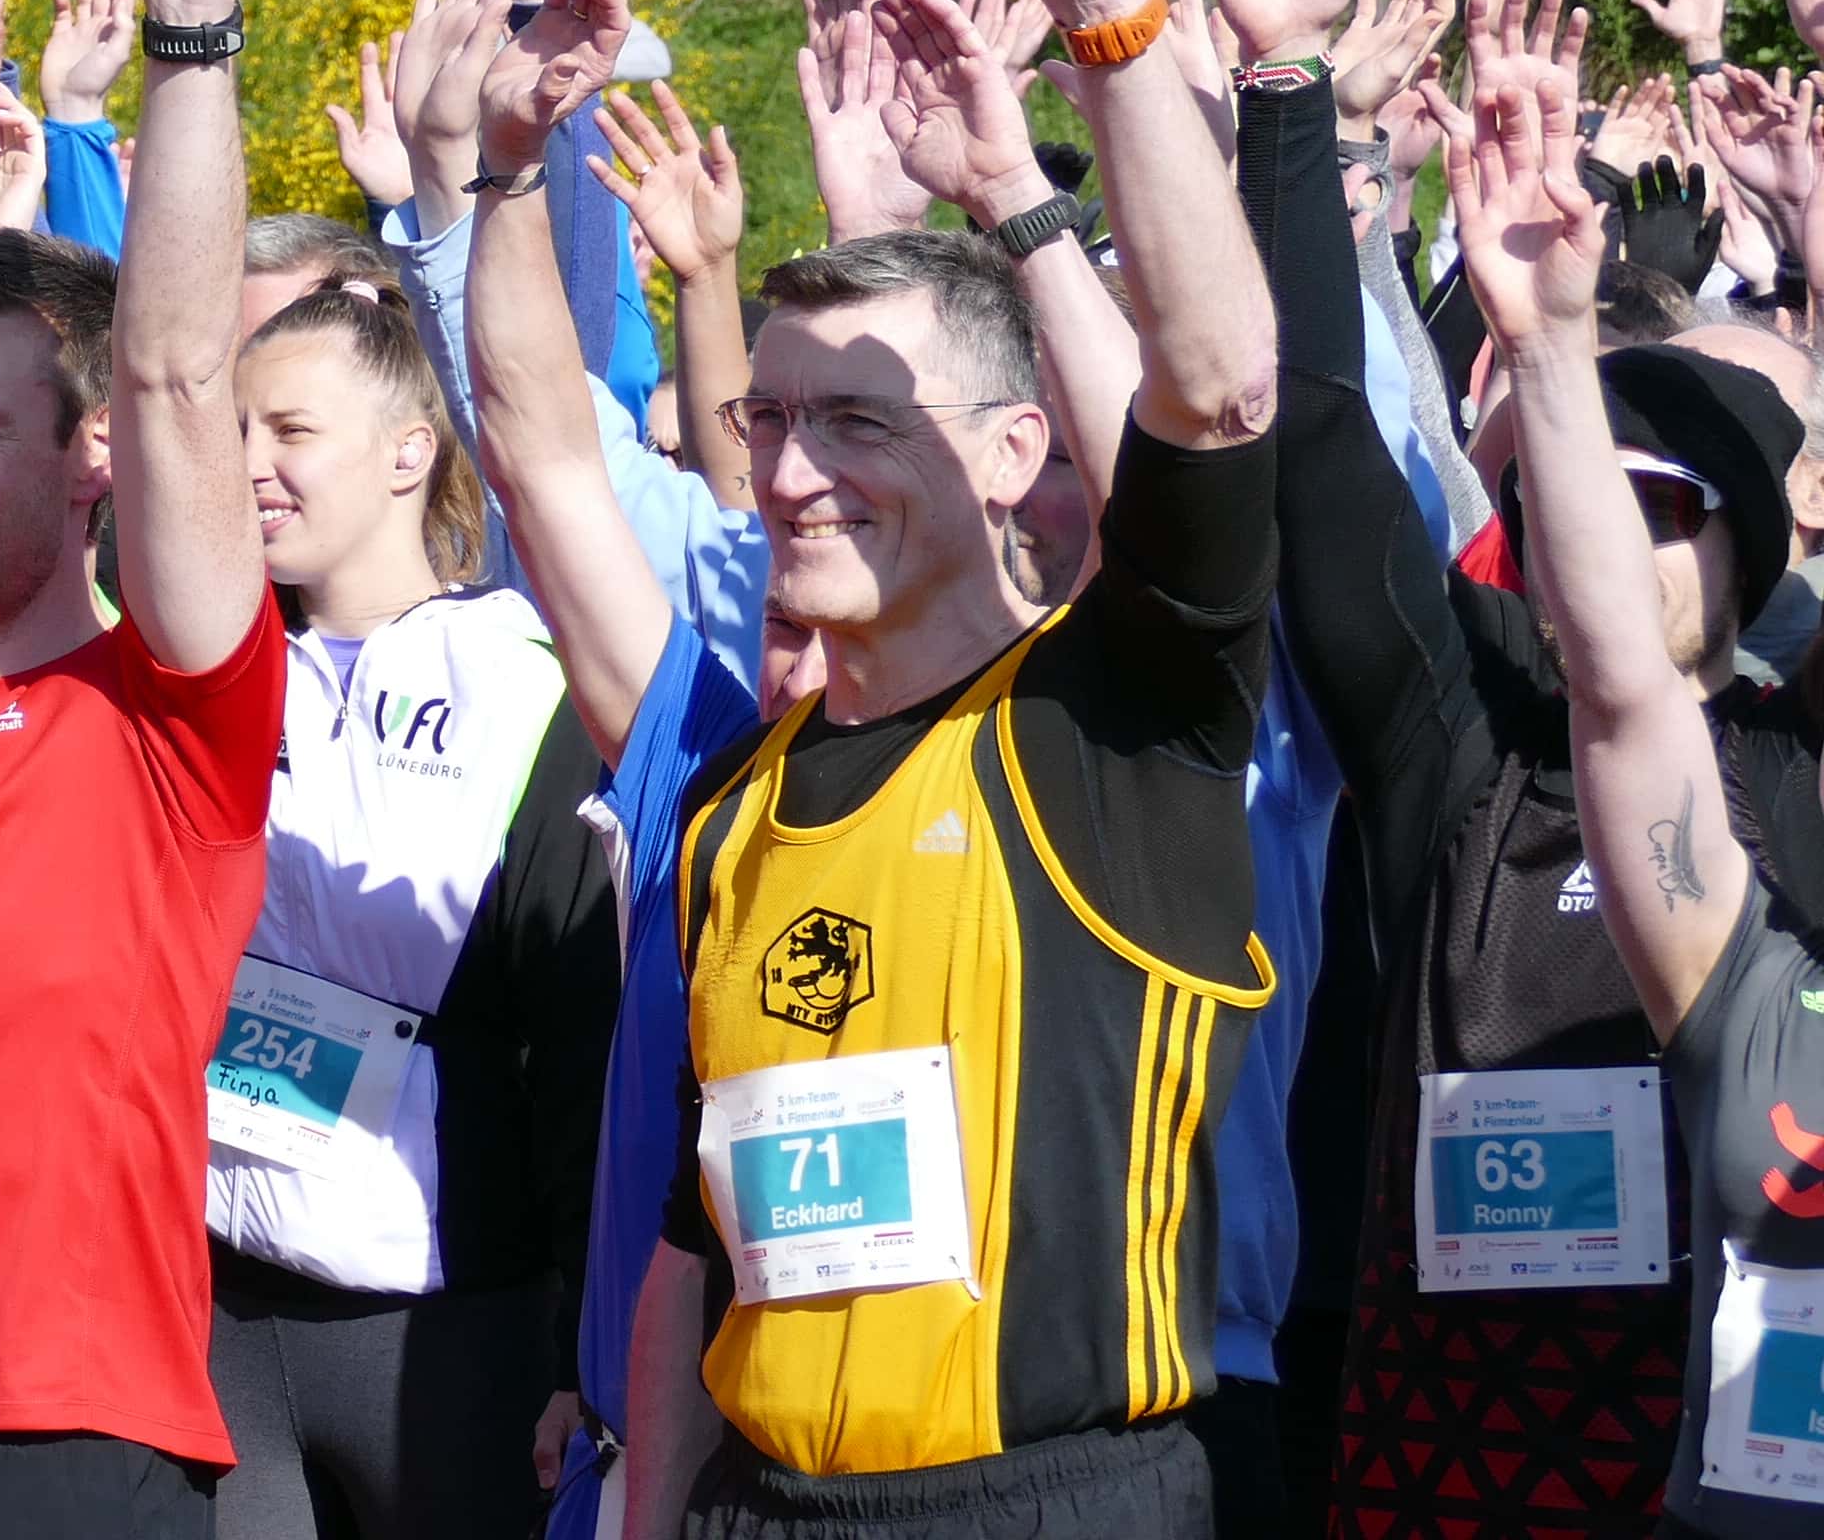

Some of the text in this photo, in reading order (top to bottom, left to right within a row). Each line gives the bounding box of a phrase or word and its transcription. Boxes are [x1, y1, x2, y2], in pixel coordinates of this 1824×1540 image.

[377, 753, 462, 779] LÜNEBURG
[230, 1019, 317, 1079] 254
[219, 1063, 279, 1106] Finja
[1473, 1100, 1481, 1110] 5
[780, 1133, 841, 1192] 71
[1475, 1140, 1546, 1192] 63
[771, 1196, 864, 1230] Eckhard
[1473, 1204, 1553, 1229] Ronny
